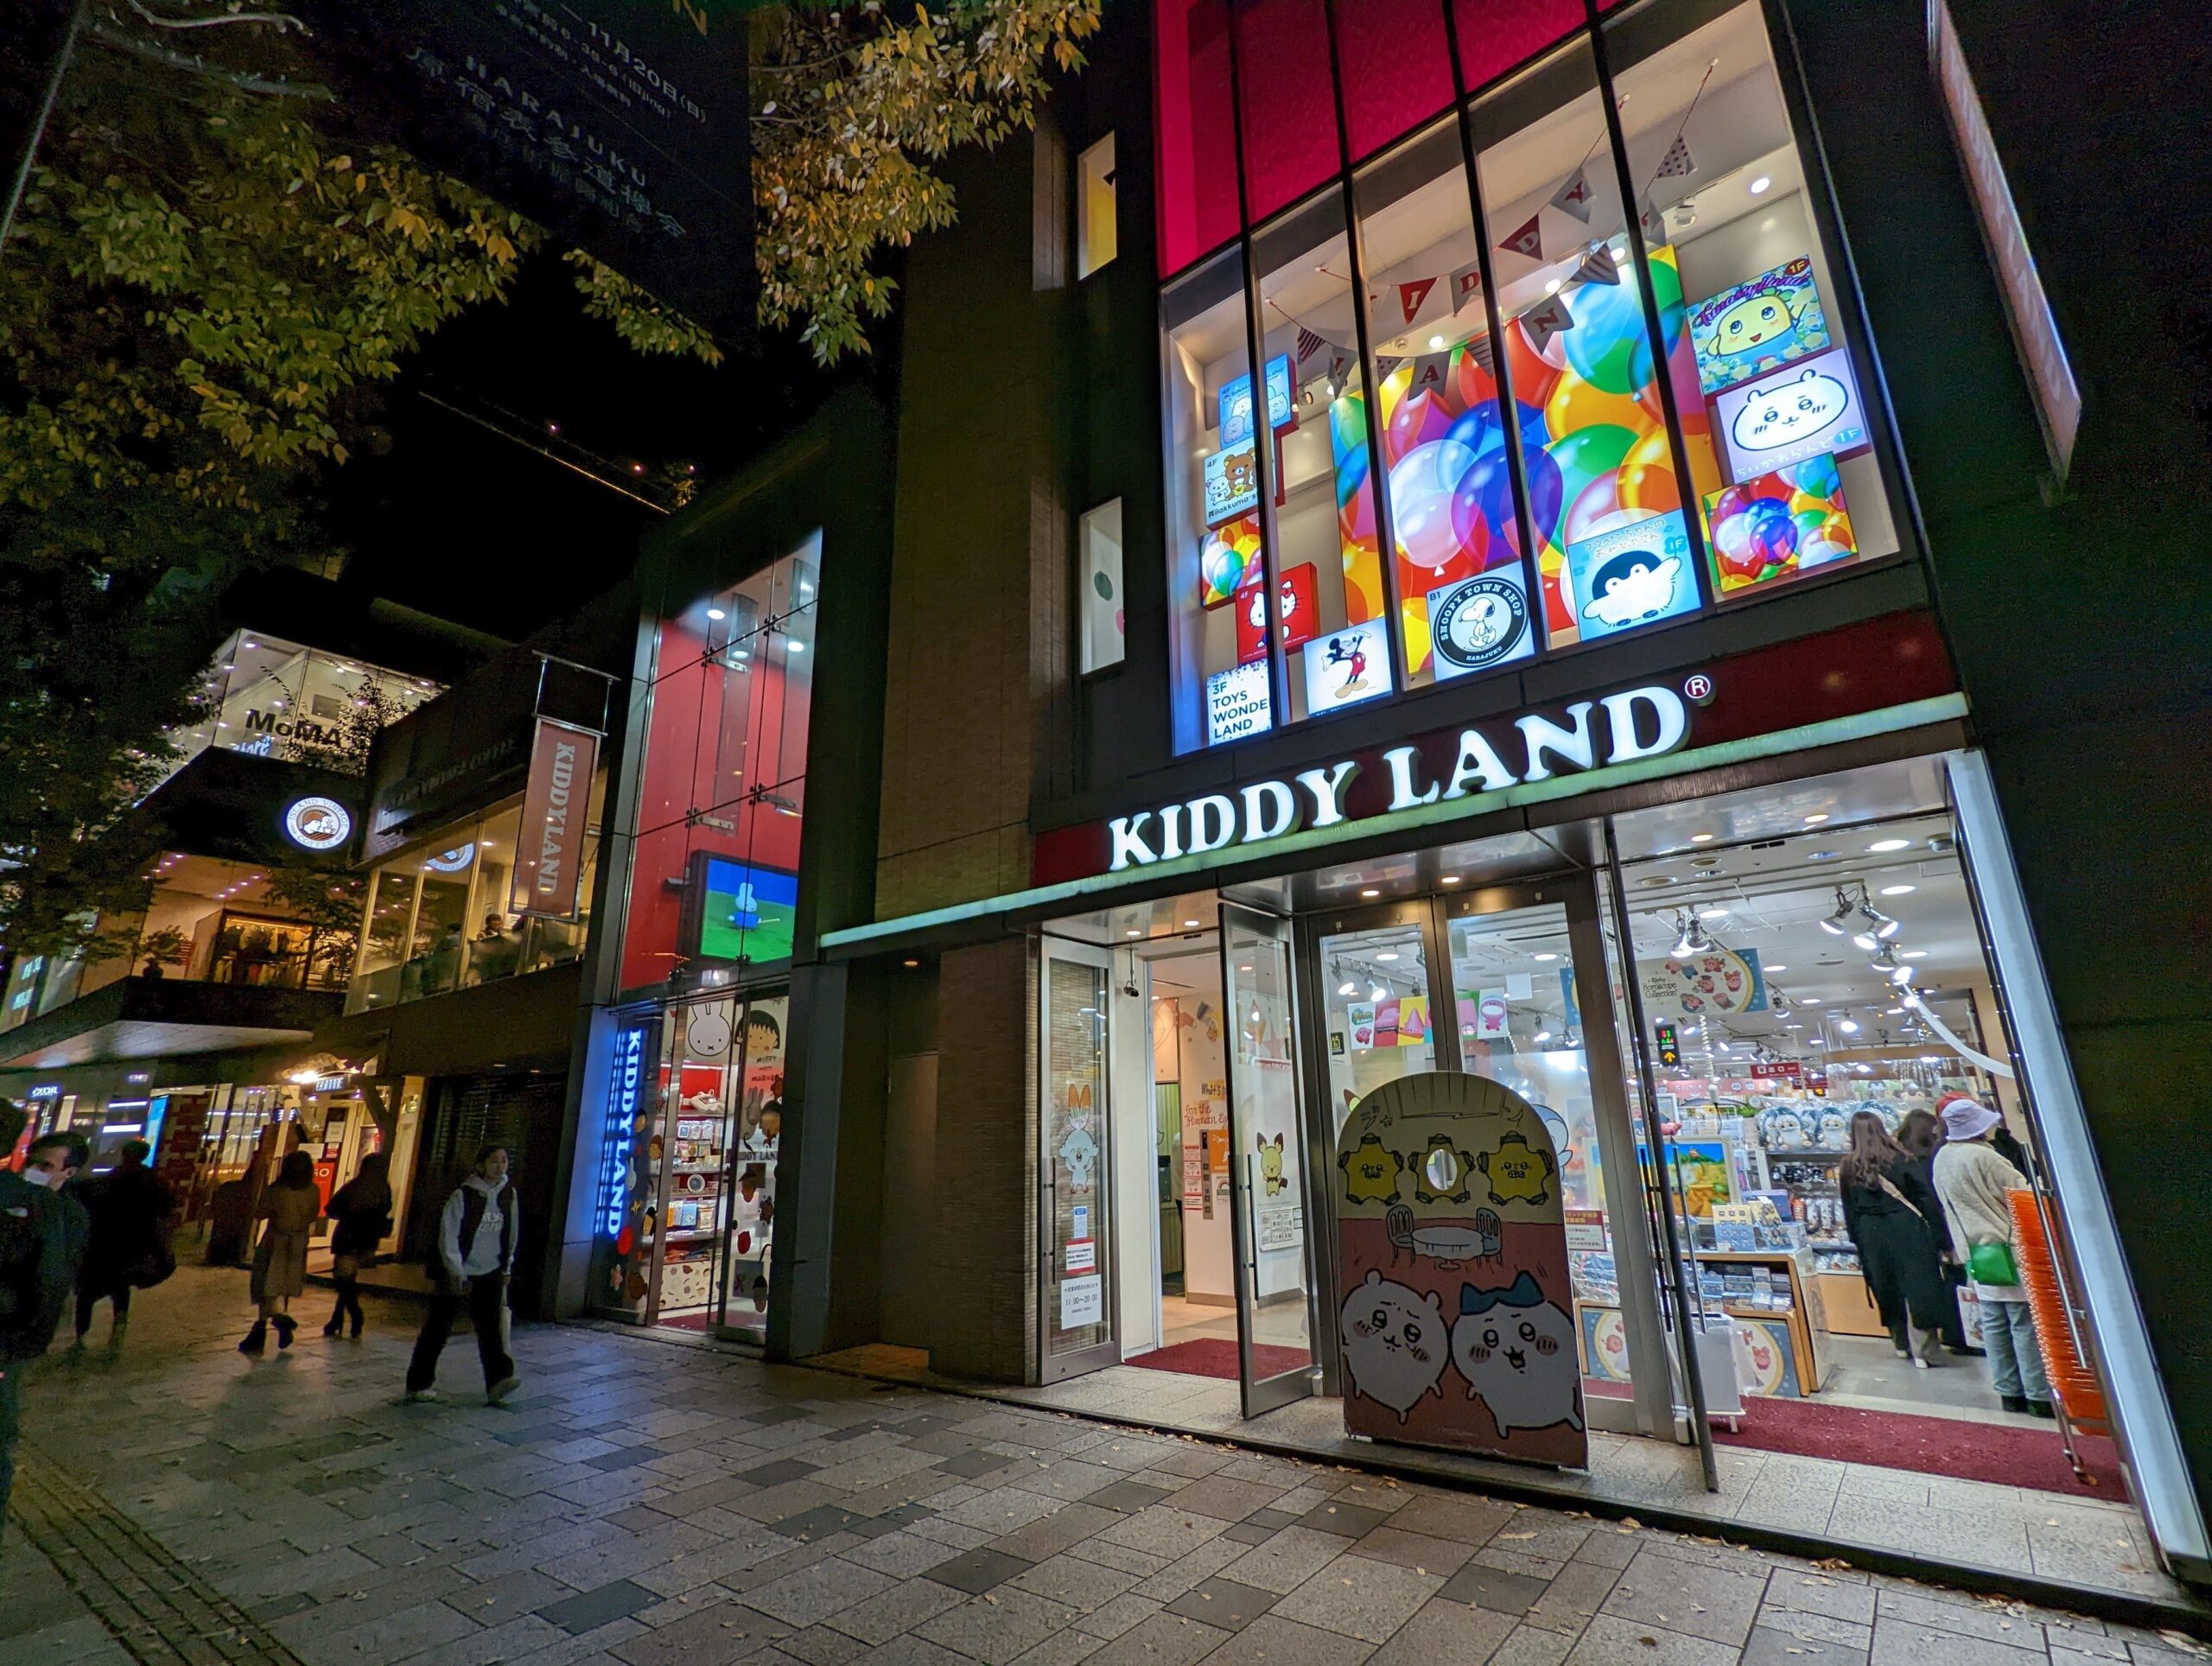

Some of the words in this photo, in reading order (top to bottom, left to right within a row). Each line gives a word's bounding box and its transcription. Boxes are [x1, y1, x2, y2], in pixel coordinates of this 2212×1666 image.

[1789, 261, 1806, 273] 1F
[1838, 428, 1859, 442] 1F
[1207, 459, 1217, 467] 4F
[1208, 497, 1249, 518] Rilakkuma
[1669, 538, 1684, 550] 1F
[1240, 590, 1249, 599] 4F
[1429, 591, 1441, 601] B1
[1440, 595, 1463, 641] SNOOPY
[1465, 582, 1503, 597] TOWN
[1503, 588, 1522, 616] SHOP
[1465, 645, 1503, 661] HARAJUKU
[1213, 681, 1227, 695] 3F
[1213, 690, 1248, 709] TOYS
[1214, 698, 1268, 724] WONDE
[245, 708, 341, 748] MoMA
[1214, 719, 1253, 739] LAND
[1109, 760, 1357, 870] KIDDY
[1382, 686, 1686, 811] LAND
[289, 798, 319, 820] ISLAND
[323, 799, 348, 829] VINTAGE
[537, 741, 575, 896] KIDDYLAND
[297, 835, 334, 848] COFFEE
